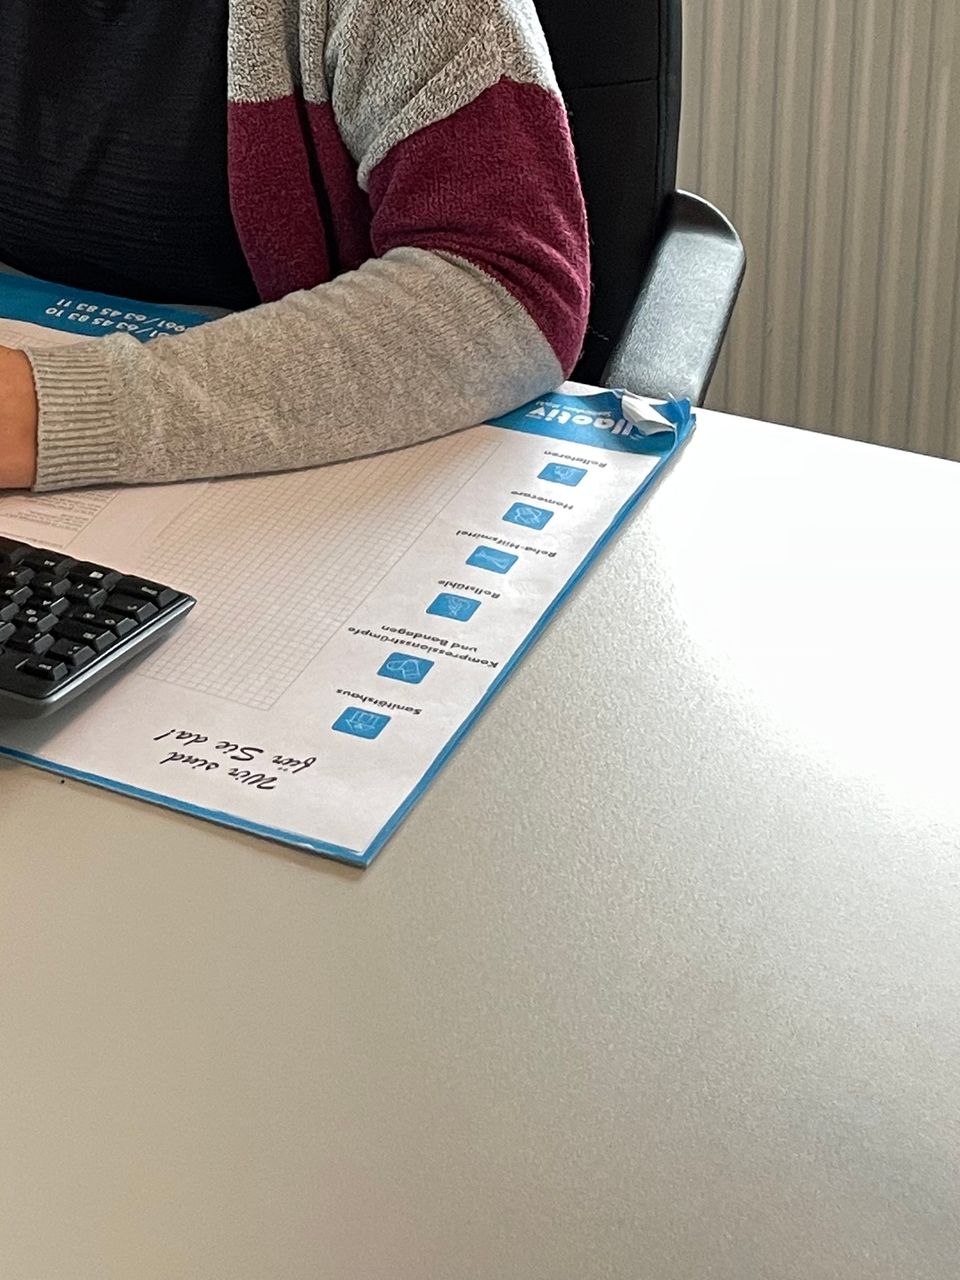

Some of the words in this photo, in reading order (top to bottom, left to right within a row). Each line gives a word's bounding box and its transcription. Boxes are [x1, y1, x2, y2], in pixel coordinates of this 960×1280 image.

[45, 307, 64, 317] 10
[67, 312, 90, 322] 83
[76, 303, 99, 313] 83
[99, 307, 123, 317] 45
[91, 317, 114, 327] 45
[543, 449, 607, 468] Rollatoren
[510, 489, 574, 510] Homecare
[455, 530, 557, 558] Reha-Hilfsmittel
[437, 579, 501, 599] Rollstühle
[381, 624, 448, 648] Bandagen
[450, 640, 478, 652] und
[347, 625, 499, 669] Kompressionsstrümpfe
[336, 687, 422, 716] Sanitätshaus
[153, 728, 209, 747] da!
[215, 739, 265, 762] Sie
[160, 751, 220, 772] sind
[272, 754, 317, 775] für
[228, 766, 278, 791] Wir
